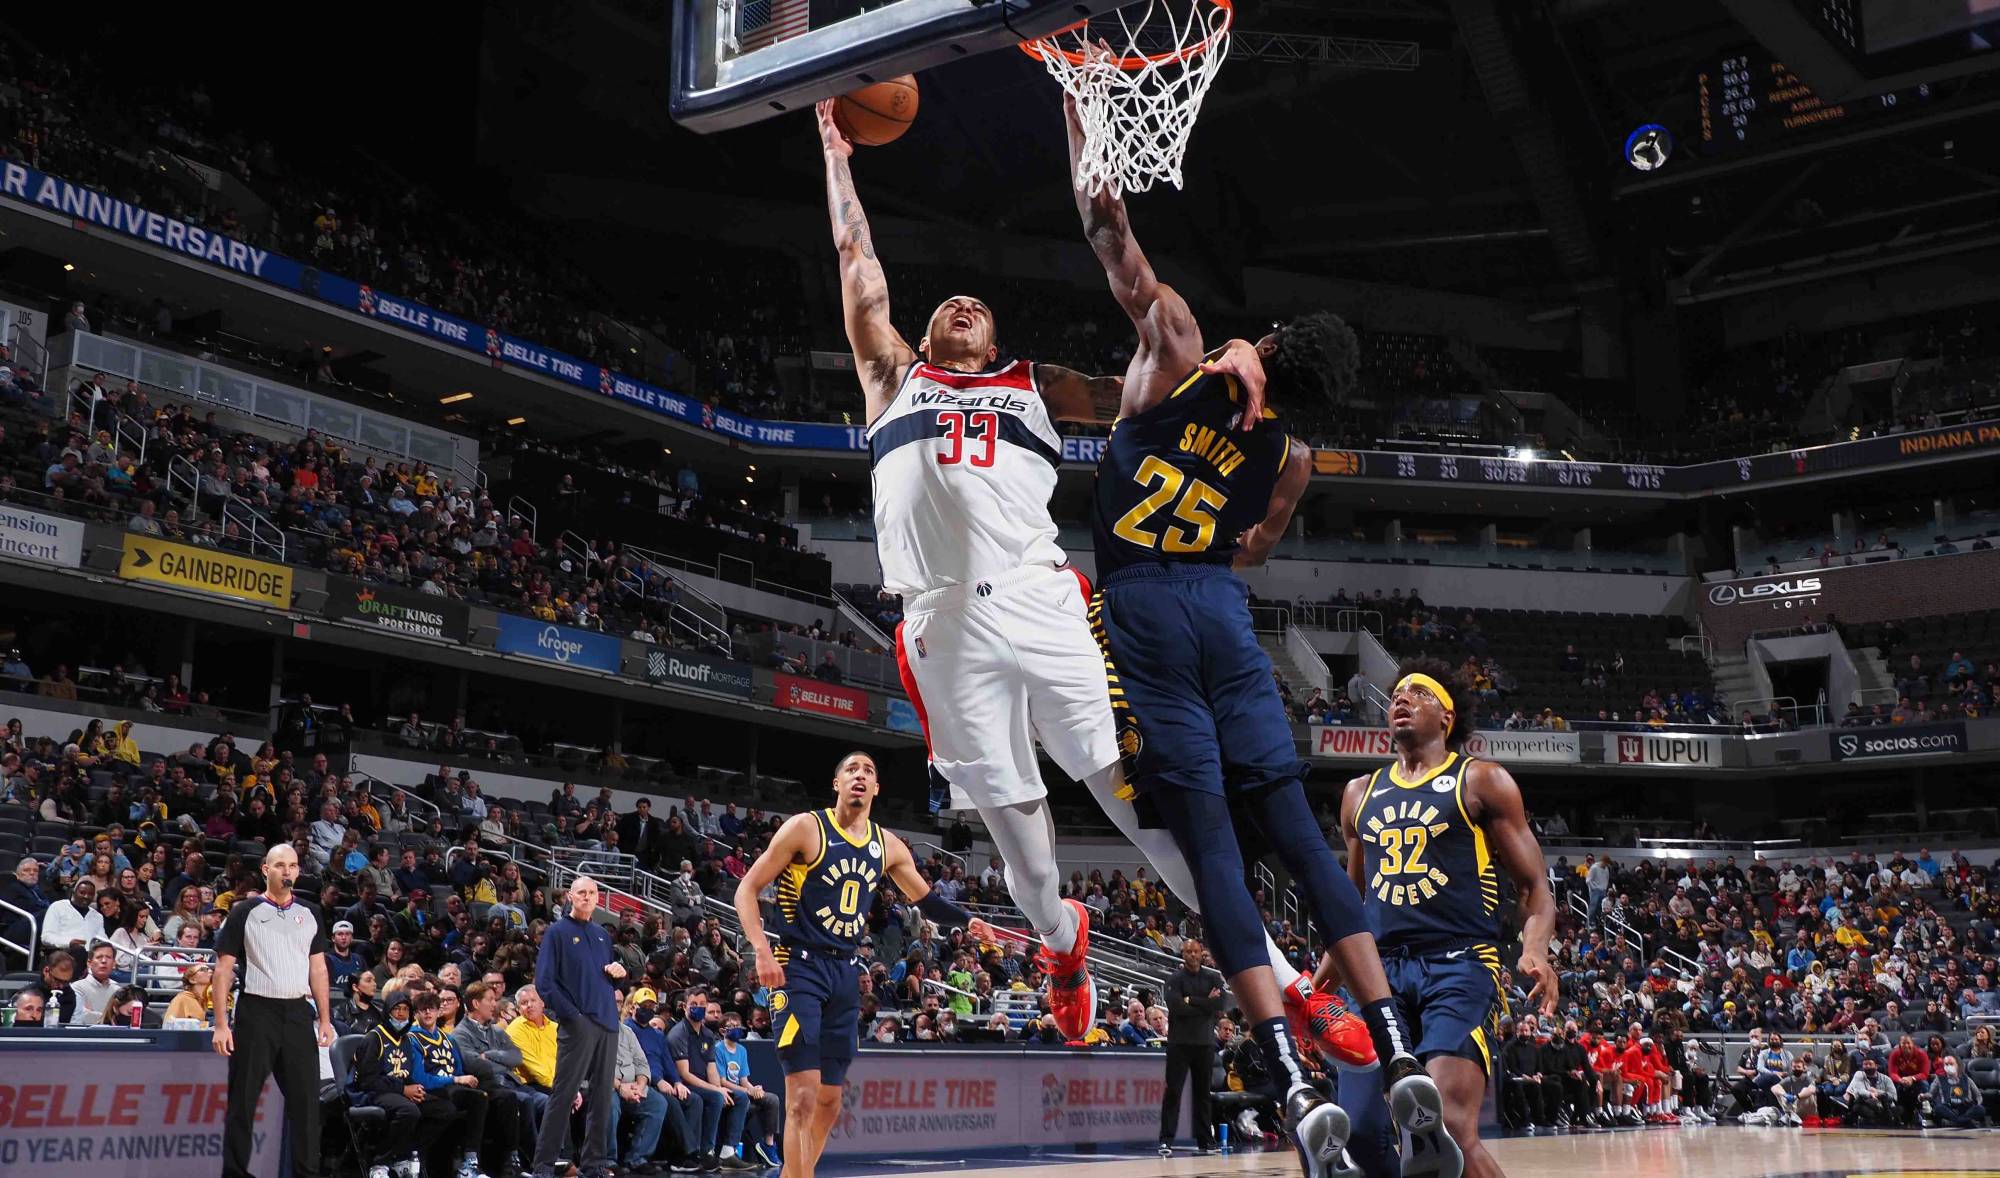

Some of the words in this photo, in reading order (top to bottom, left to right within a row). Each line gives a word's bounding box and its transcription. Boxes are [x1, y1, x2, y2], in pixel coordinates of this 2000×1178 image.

[37, 175, 268, 277] ANNIVERSARY
[18, 310, 33, 326] 105
[379, 300, 429, 329] BELLE
[432, 319, 468, 342] TIRE
[503, 341, 548, 367] BELLE
[550, 358, 583, 381] TIRE
[614, 380, 654, 405] BELLE
[657, 393, 687, 416] TIRE
[715, 417, 755, 439] BELLE
[757, 423, 795, 443] TIRE
[936, 411, 999, 467] 33
[1900, 430, 1975, 455] INDIANA
[1178, 422, 1246, 478] SMITH
[1397, 463, 1416, 478] 25
[1440, 464, 1458, 479] 20
[1483, 465, 1527, 482] 30/52
[1558, 470, 1592, 487] 8/16
[1627, 473, 1661, 489] 4/15
[1112, 455, 1229, 552] 25
[160, 552, 284, 598] GAINBRIDGE
[1739, 577, 1822, 598] LEXUS
[358, 598, 444, 626] DRAFTKINGS
[1772, 598, 1818, 610] LOFT
[378, 616, 442, 639] SPORTSBOOK
[538, 625, 583, 662] Kroger
[668, 655, 711, 682] Ruoff
[710, 671, 751, 688] MORTGAGE
[801, 690, 830, 707] BELLE
[832, 695, 855, 711] TIRE
[1463, 730, 1576, 761] @properties
[1648, 738, 1709, 764] IUPUI
[1865, 732, 1958, 753] socios.com
[1362, 800, 1450, 844] INDIANA
[1379, 826, 1428, 876] 32
[820, 857, 878, 893] INDIANA
[1371, 867, 1449, 906] PACERS
[839, 879, 861, 915] 0
[0, 1084, 145, 1128] BELLE
[861, 1079, 940, 1110] BELLE
[944, 1079, 998, 1109] TIRE
[1066, 1080, 1126, 1106] BELLE
[861, 1116, 882, 1134] 100
[884, 1115, 916, 1133] YEAR
[918, 1112, 998, 1132] ANNIVERSARY
[1087, 1109, 1110, 1127] YEAR
[26, 1136, 94, 1163] YEAR
